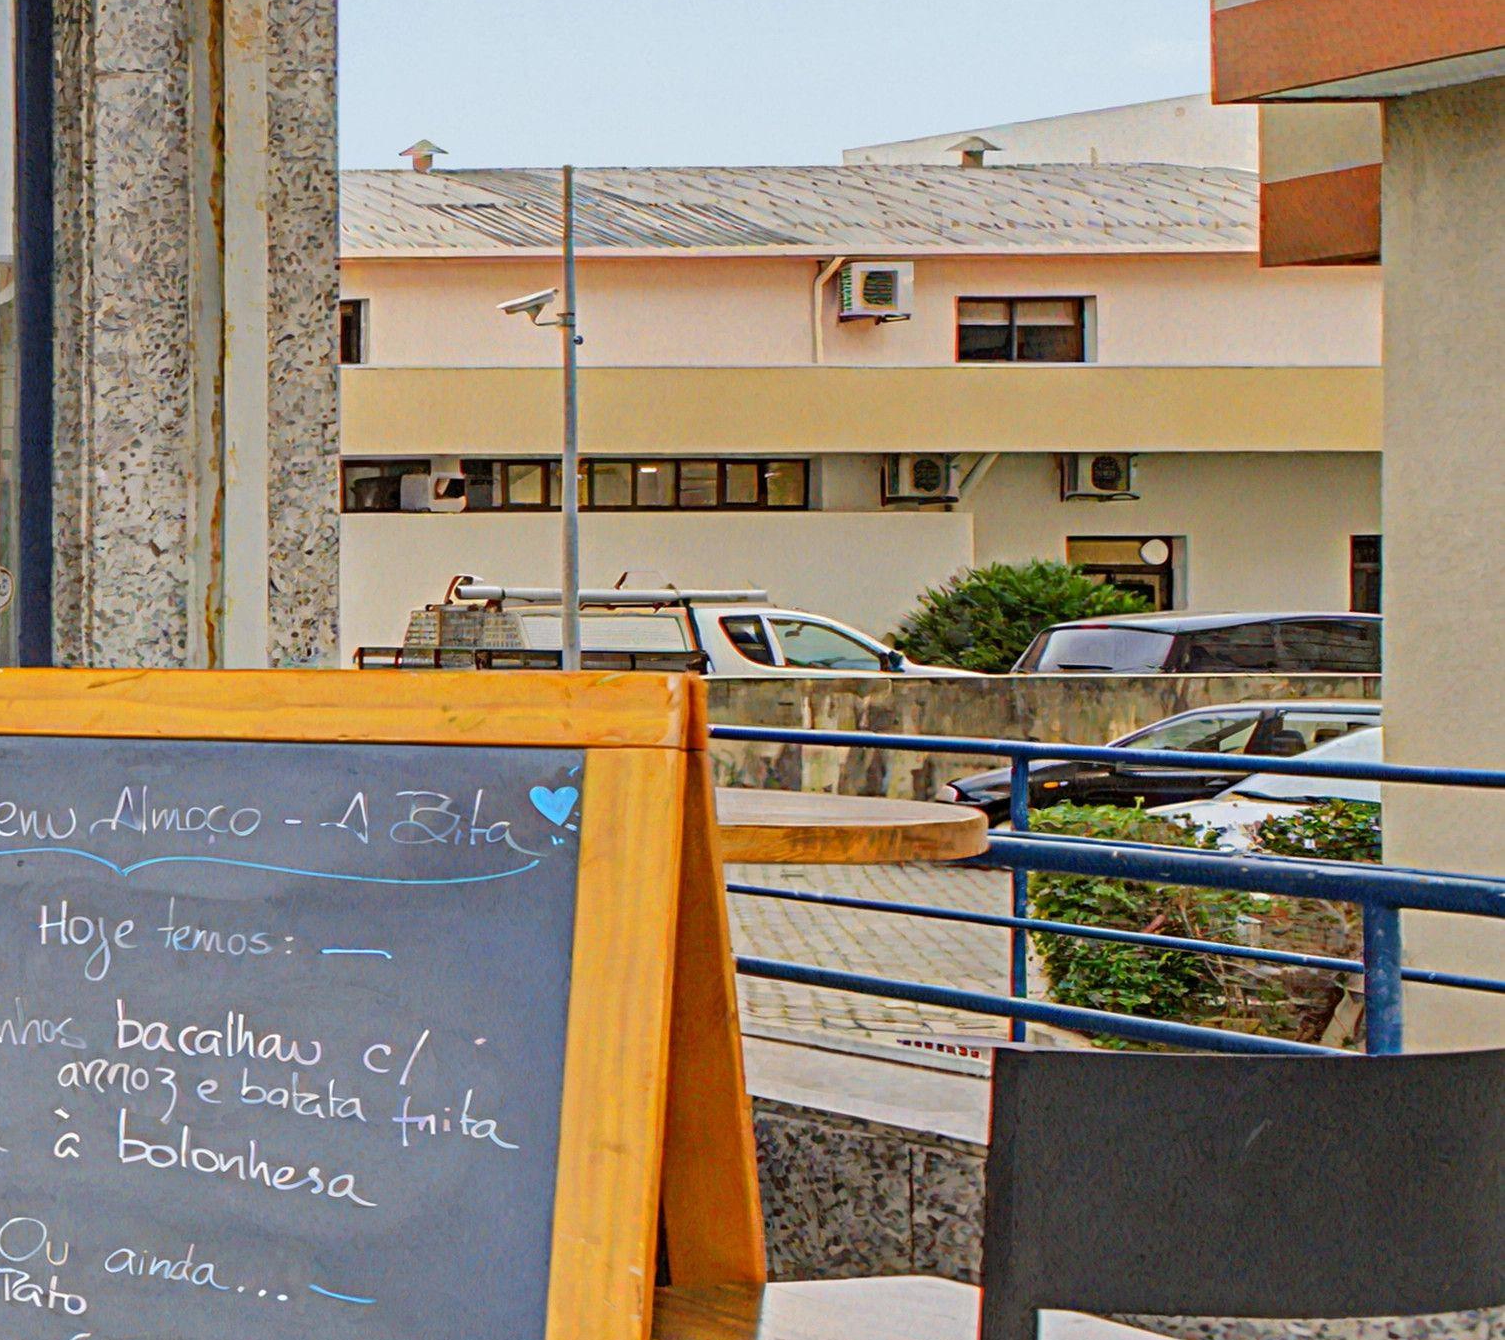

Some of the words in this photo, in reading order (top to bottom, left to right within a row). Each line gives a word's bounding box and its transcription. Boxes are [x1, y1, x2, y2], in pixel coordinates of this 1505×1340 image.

[389, 789, 548, 858] Bita
[38, 900, 136, 981] Hoje
[116, 998, 323, 1065] bacalhau
[362, 1028, 431, 1086] c/
[57, 1058, 179, 1125] arroz
[197, 1078, 223, 1105] e
[240, 1068, 368, 1123] batata
[391, 1088, 520, 1150] frita
[118, 1108, 378, 1208] bolonhesa
